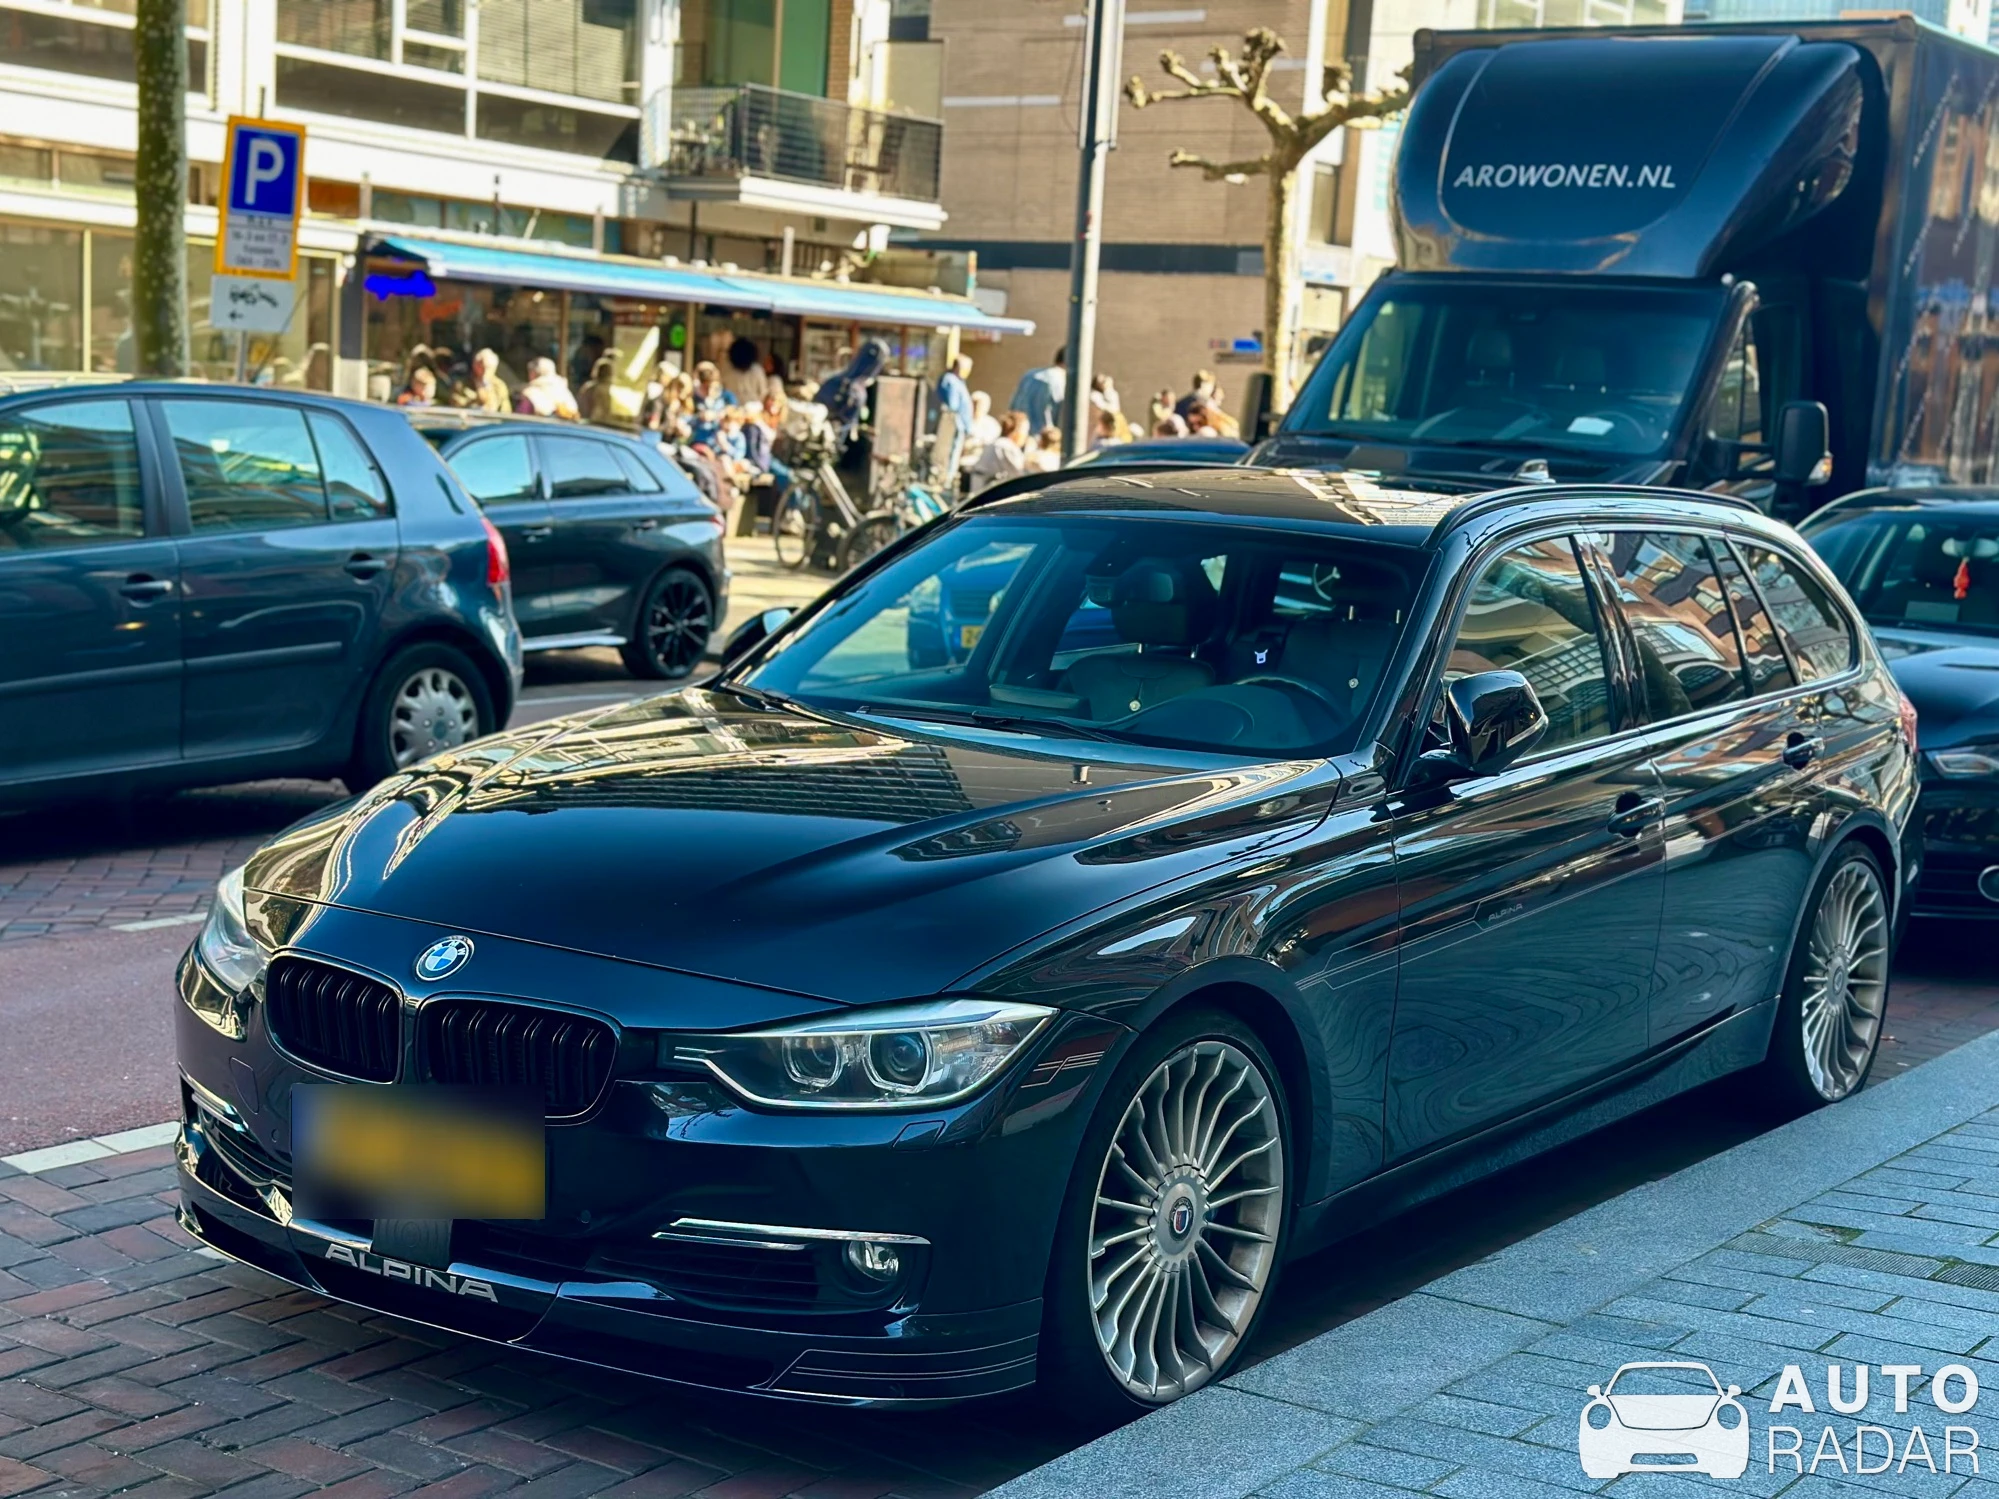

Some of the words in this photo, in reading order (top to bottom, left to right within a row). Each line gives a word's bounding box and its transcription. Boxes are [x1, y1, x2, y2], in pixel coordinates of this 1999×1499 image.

[244, 138, 285, 205] P
[1453, 164, 1676, 188] AROWONEN.NL
[324, 1243, 499, 1304] ALPINA
